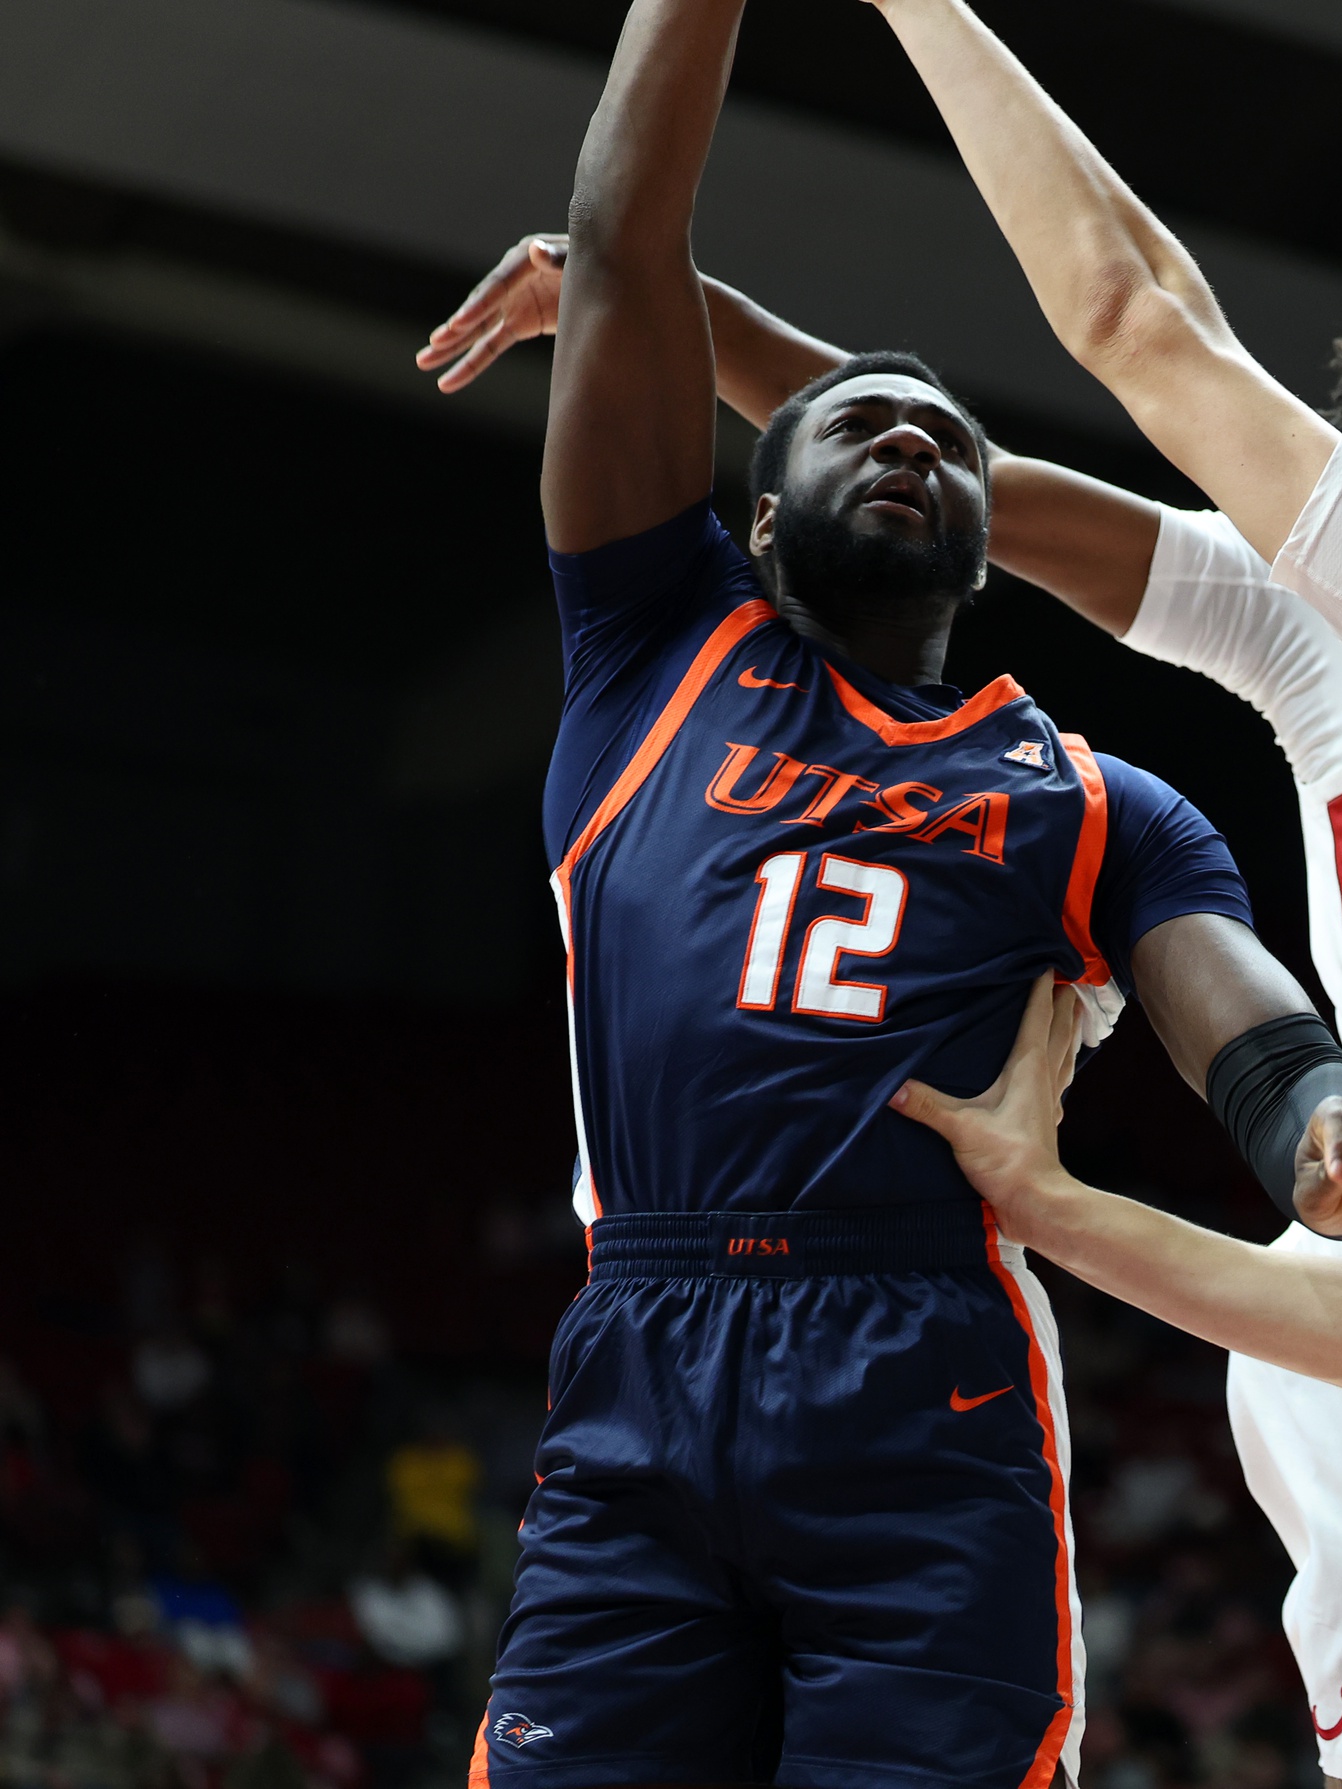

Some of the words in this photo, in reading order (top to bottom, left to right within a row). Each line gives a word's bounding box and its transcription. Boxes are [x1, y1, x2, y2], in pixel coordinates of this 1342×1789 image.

[705, 742, 1010, 865] UTSA
[736, 851, 909, 1023] 12
[728, 1238, 790, 1256] UTSA
